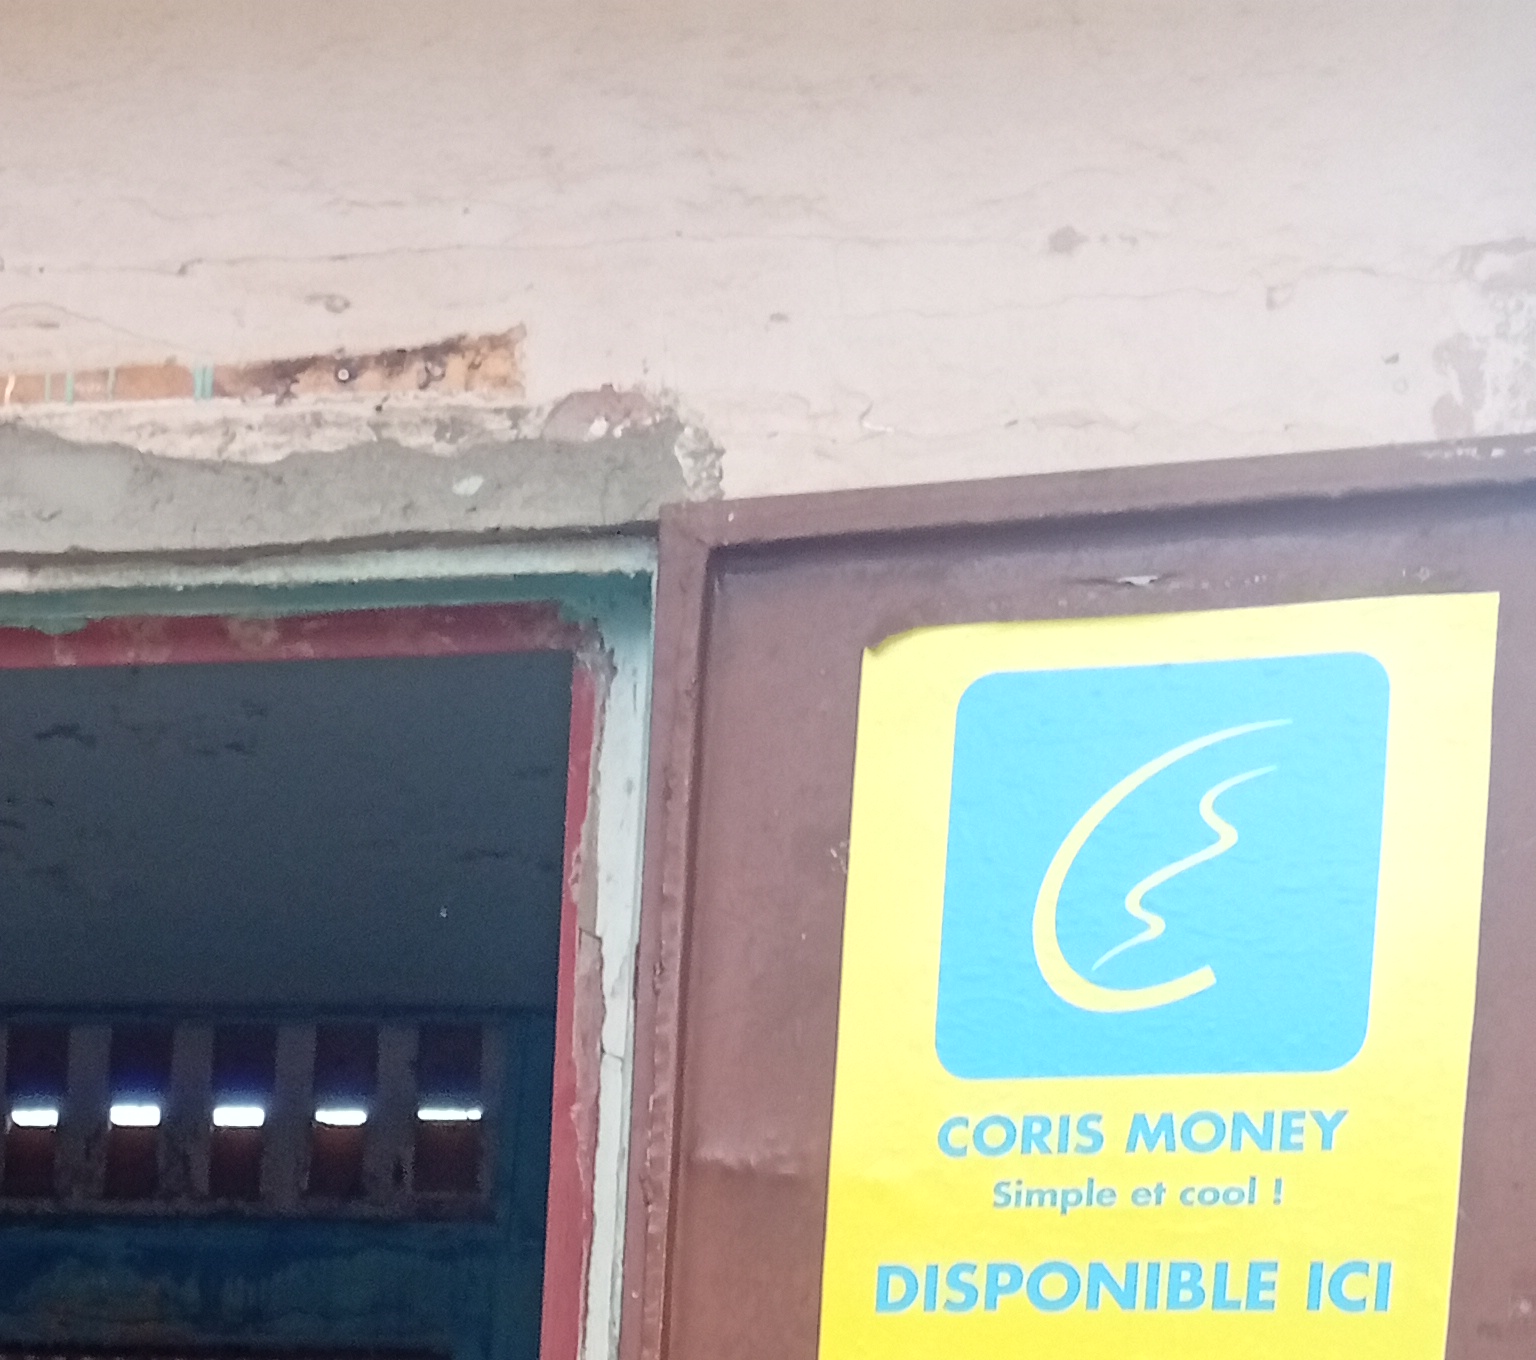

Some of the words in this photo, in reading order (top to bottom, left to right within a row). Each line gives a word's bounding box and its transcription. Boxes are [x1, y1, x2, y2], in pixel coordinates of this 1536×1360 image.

[936, 1113, 1104, 1158] CORIS
[1124, 1108, 1349, 1154] MONEY
[992, 1177, 1117, 1215] Simple
[1130, 1182, 1167, 1208] et
[1178, 1176, 1257, 1207] cool
[1272, 1177, 1284, 1206] !
[873, 1261, 1279, 1314] DISPONIBLE
[1306, 1261, 1393, 1313] ICI
